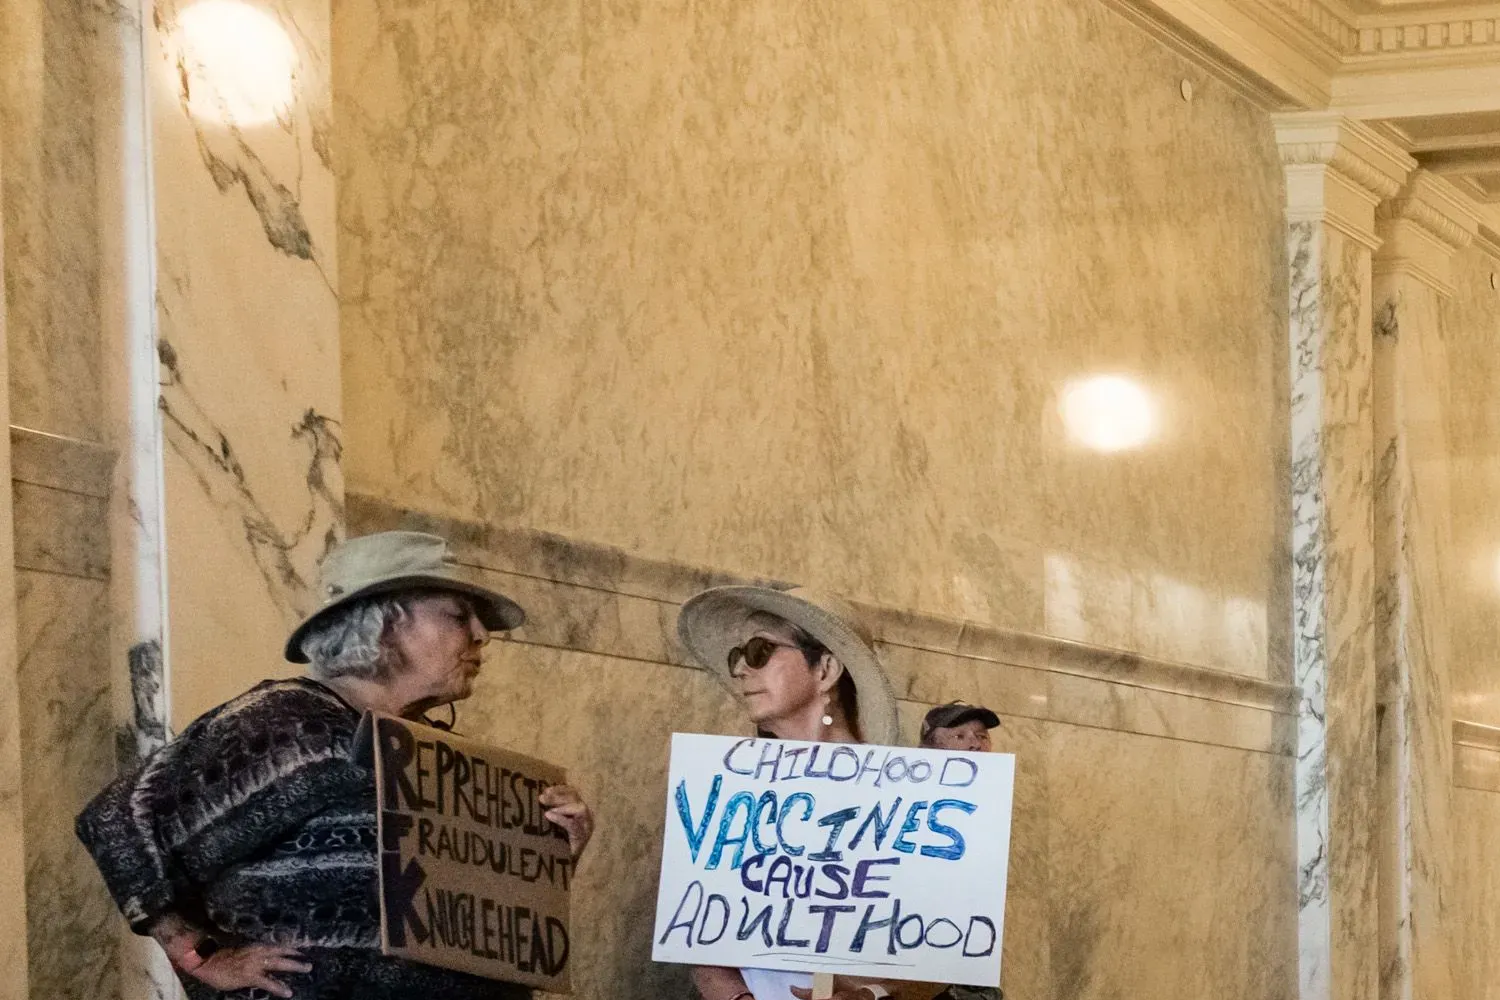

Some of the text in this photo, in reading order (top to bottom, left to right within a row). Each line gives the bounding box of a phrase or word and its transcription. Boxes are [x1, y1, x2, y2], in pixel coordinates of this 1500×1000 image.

[722, 738, 979, 788] CHILDHOOD
[382, 811, 571, 892] FRAUDULENT
[674, 774, 979, 871] VACCINES
[740, 853, 901, 900] CAUSE
[658, 880, 997, 958] ADULTHOOD
